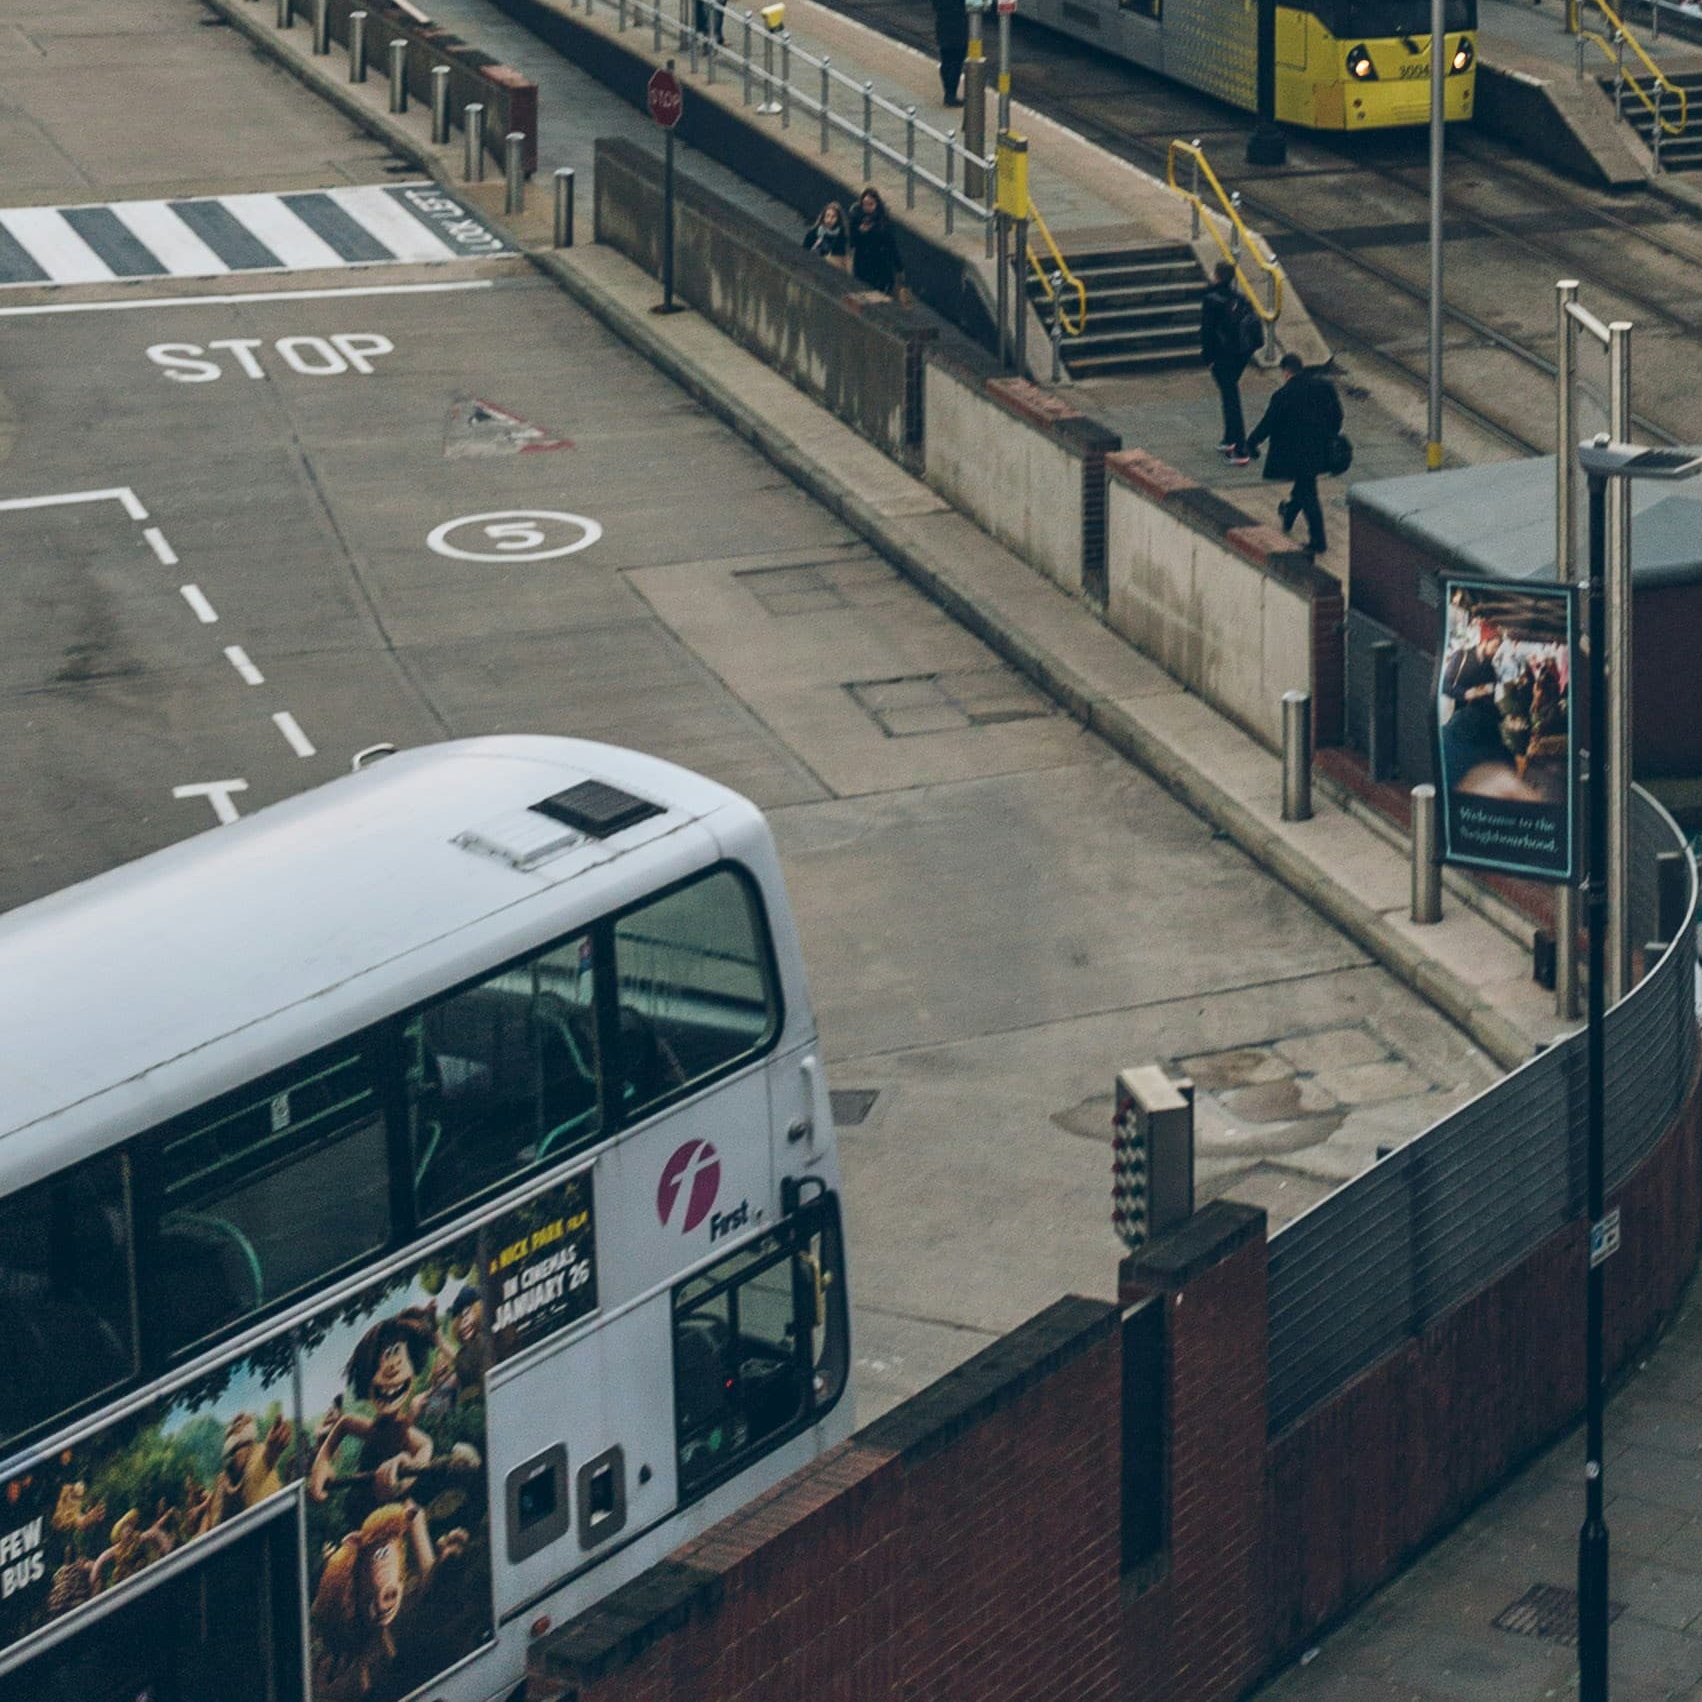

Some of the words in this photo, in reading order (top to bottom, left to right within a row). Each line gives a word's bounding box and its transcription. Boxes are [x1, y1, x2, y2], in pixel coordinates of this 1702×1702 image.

[650, 89, 681, 108] STOP
[404, 189, 466, 219] LEFT
[441, 218, 504, 252] LOOK
[146, 333, 395, 383] STOP
[484, 521, 545, 550] 5
[1460, 804, 1517, 826] Welcome
[1519, 816, 1533, 829] to
[1535, 816, 1556, 832] the
[500, 1237, 529, 1270] NICK
[531, 1217, 565, 1252] PARK
[566, 1210, 589, 1233] FILM
[710, 1198, 749, 1244] First
[503, 1275, 519, 1300] IN
[520, 1243, 577, 1291] CINEMAS
[490, 1269, 566, 1334] JANUARY
[568, 1258, 590, 1292] 26
[0, 1516, 43, 1567] FEW
[2, 1548, 46, 1599] BUS
